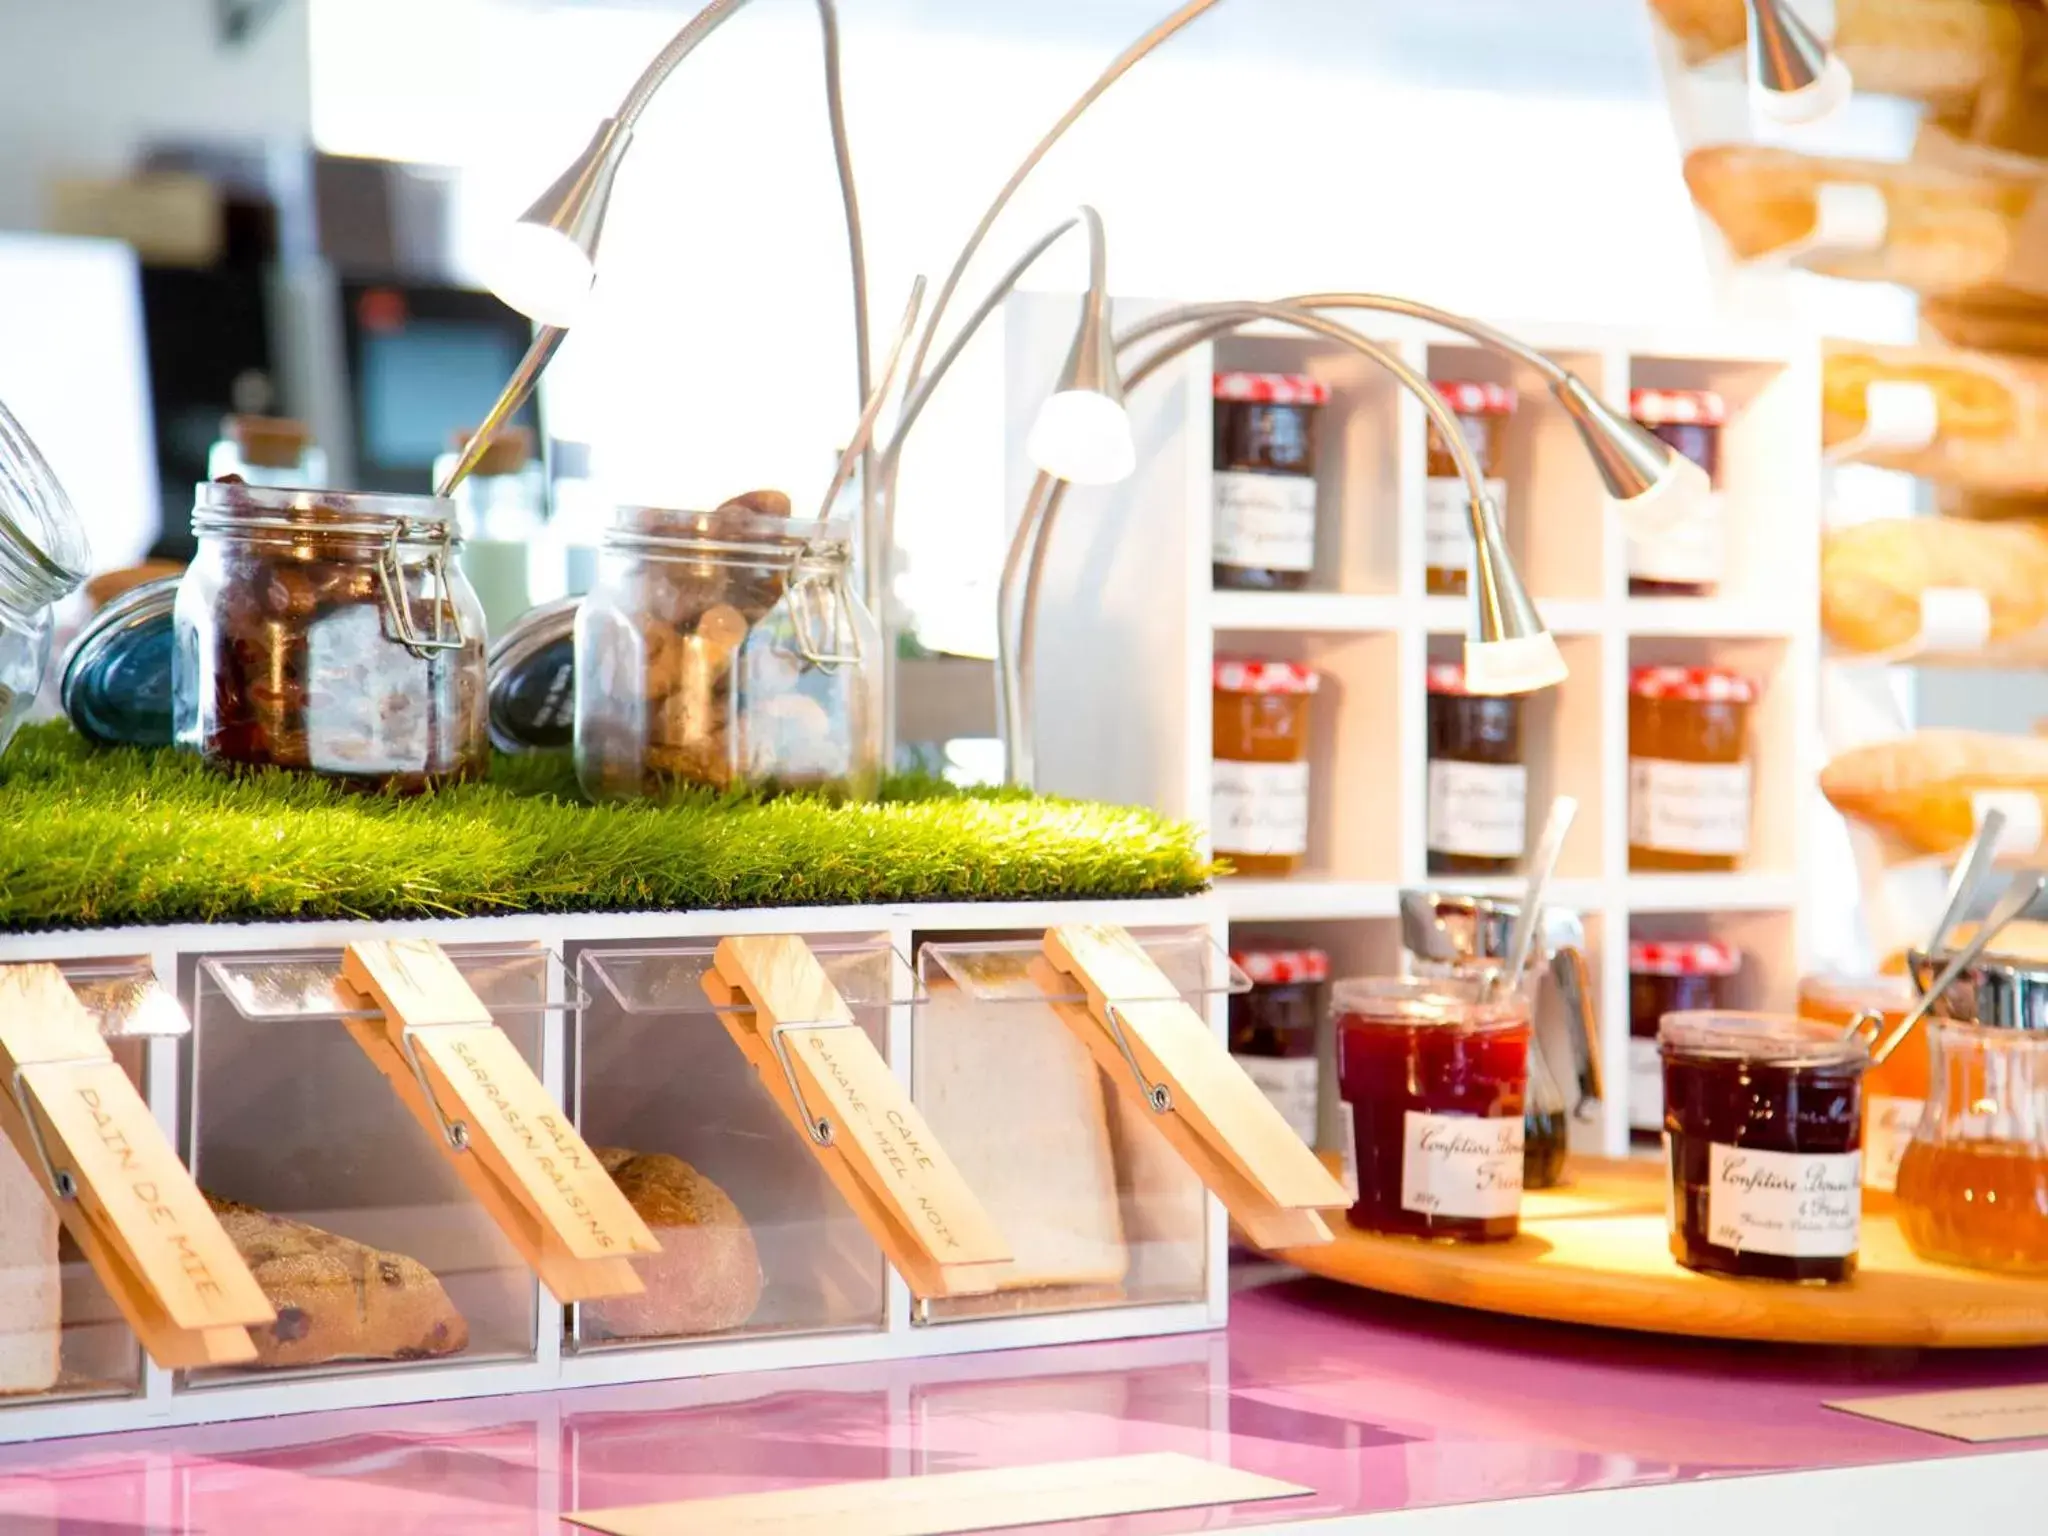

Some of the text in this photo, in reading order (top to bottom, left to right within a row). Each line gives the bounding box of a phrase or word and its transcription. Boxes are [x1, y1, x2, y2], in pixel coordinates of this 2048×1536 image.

[451, 1041, 615, 1249] SARRASIN RAISINS
[536, 1113, 590, 1171] PAIN
[885, 1109, 935, 1170] CAKE
[77, 1087, 223, 1299] PAIN DE MIE
[918, 1196, 960, 1248] NOIX
